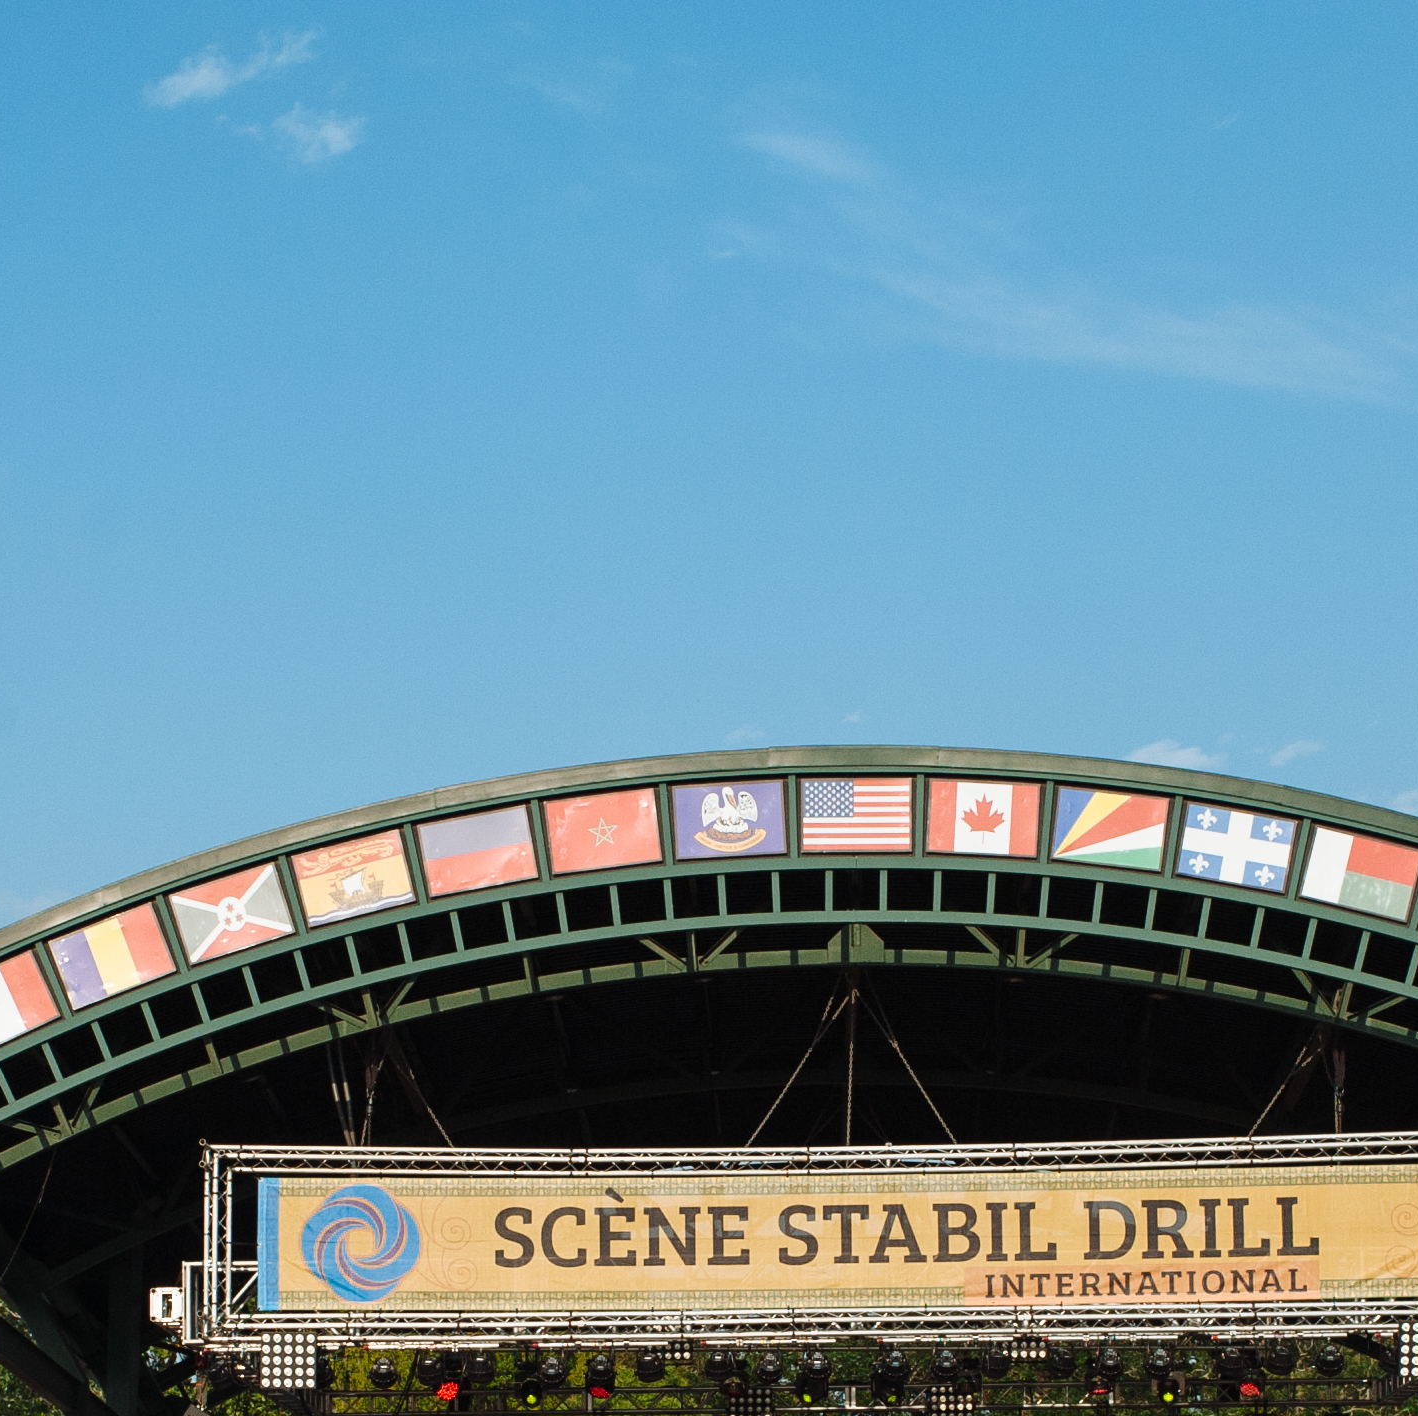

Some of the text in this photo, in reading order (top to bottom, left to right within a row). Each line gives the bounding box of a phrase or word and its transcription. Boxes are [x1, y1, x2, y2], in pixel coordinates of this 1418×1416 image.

[494, 1187, 1319, 1267] SCÈNE STABIL DRILL
[985, 1268, 1307, 1298] INTERNATIONAL
